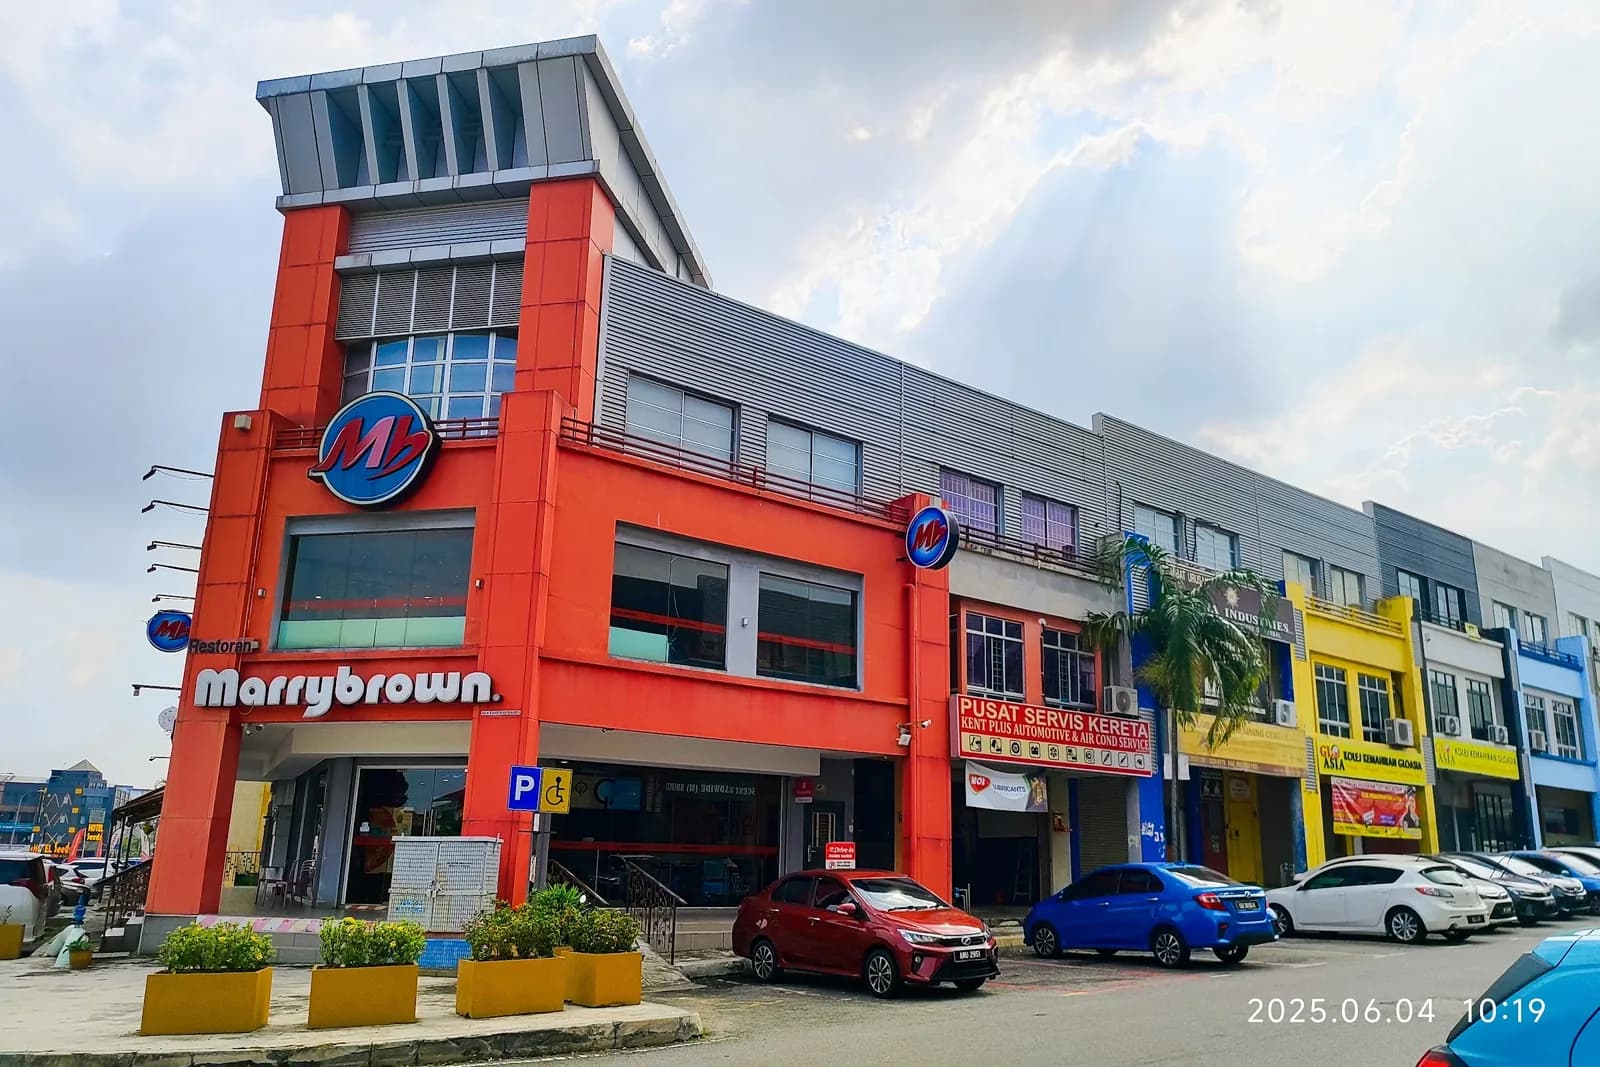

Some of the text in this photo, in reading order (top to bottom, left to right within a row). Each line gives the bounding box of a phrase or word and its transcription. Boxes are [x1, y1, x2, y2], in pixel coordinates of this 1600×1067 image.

[310, 416, 430, 480] Mb
[912, 519, 947, 552] Mb
[188, 639, 252, 654] Restoran
[960, 697, 1149, 739] PUSAT SERVIS KERETA
[961, 715, 1149, 751] KENT PLUS AUTOMOTIVE & AIR COND SERVICE
[1323, 757, 1345, 771] ASIA
[515, 775, 535, 801] P
